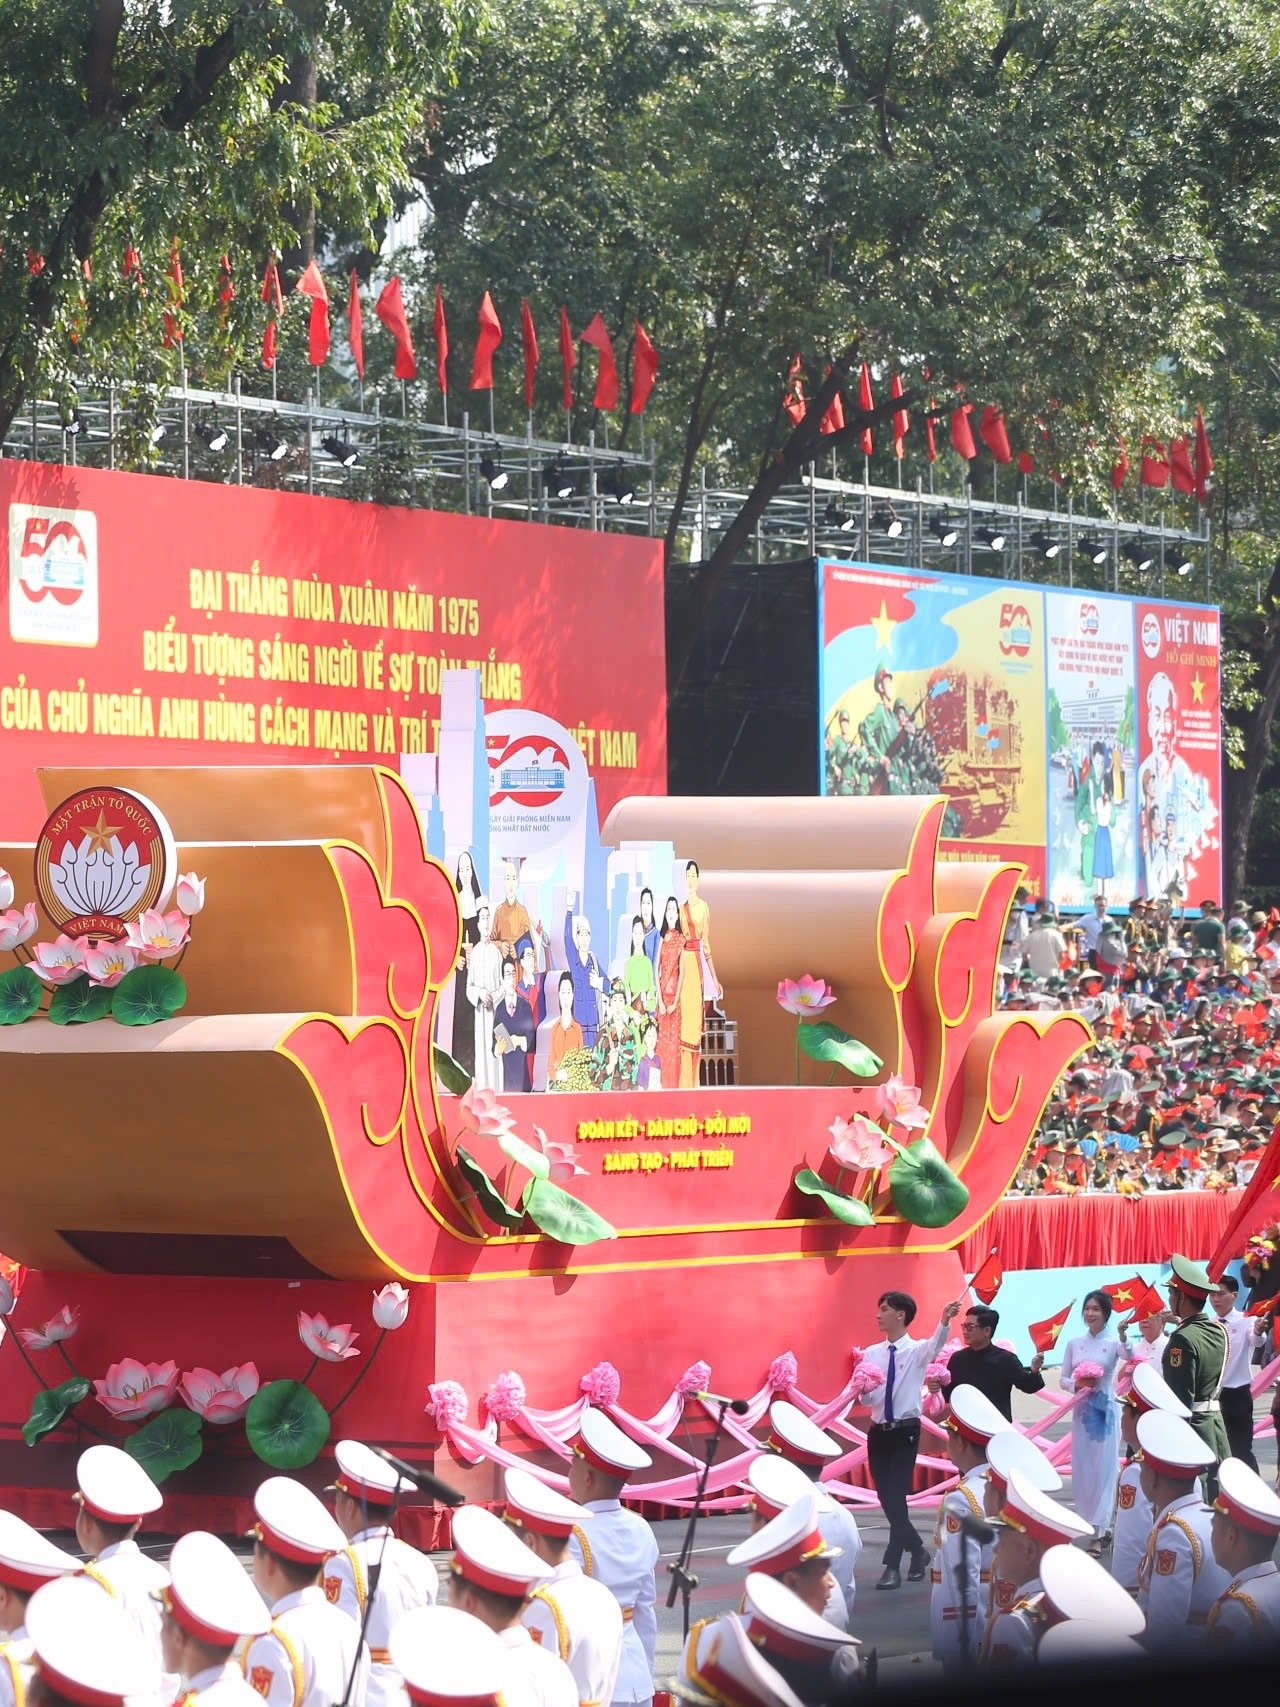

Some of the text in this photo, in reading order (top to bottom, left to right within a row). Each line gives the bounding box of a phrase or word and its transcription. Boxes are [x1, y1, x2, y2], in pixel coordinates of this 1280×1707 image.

[189, 559, 480, 637] ĐẠI THẮNG MÙA XUÂN NĂM 1975
[143, 615, 188, 675] BIỂU
[192, 632, 255, 685] TƯỢNG
[258, 633, 310, 687] SÁNG
[314, 638, 358, 690] NGỜI
[362, 640, 385, 691] VỀ
[389, 651, 415, 702] SỰ
[466, 647, 522, 701] HẮNG
[1164, 612, 1190, 648] VIỆT
[1193, 621, 1218, 646] NAM
[0, 673, 43, 731] CỦA
[47, 678, 89, 734] CHỦ
[93, 688, 154, 737] NGHĨA
[158, 697, 199, 739] ANH
[203, 692, 256, 744] HÙNG
[259, 697, 310, 747] CÁCH
[314, 709, 368, 758] MẠNG
[372, 706, 396, 754] VÀ
[400, 710, 428, 755] TRÍ
[600, 729, 637, 769] NAM
[125, 806, 152, 836] QUỐC
[70, 919, 124, 934] VIỆT NAM
